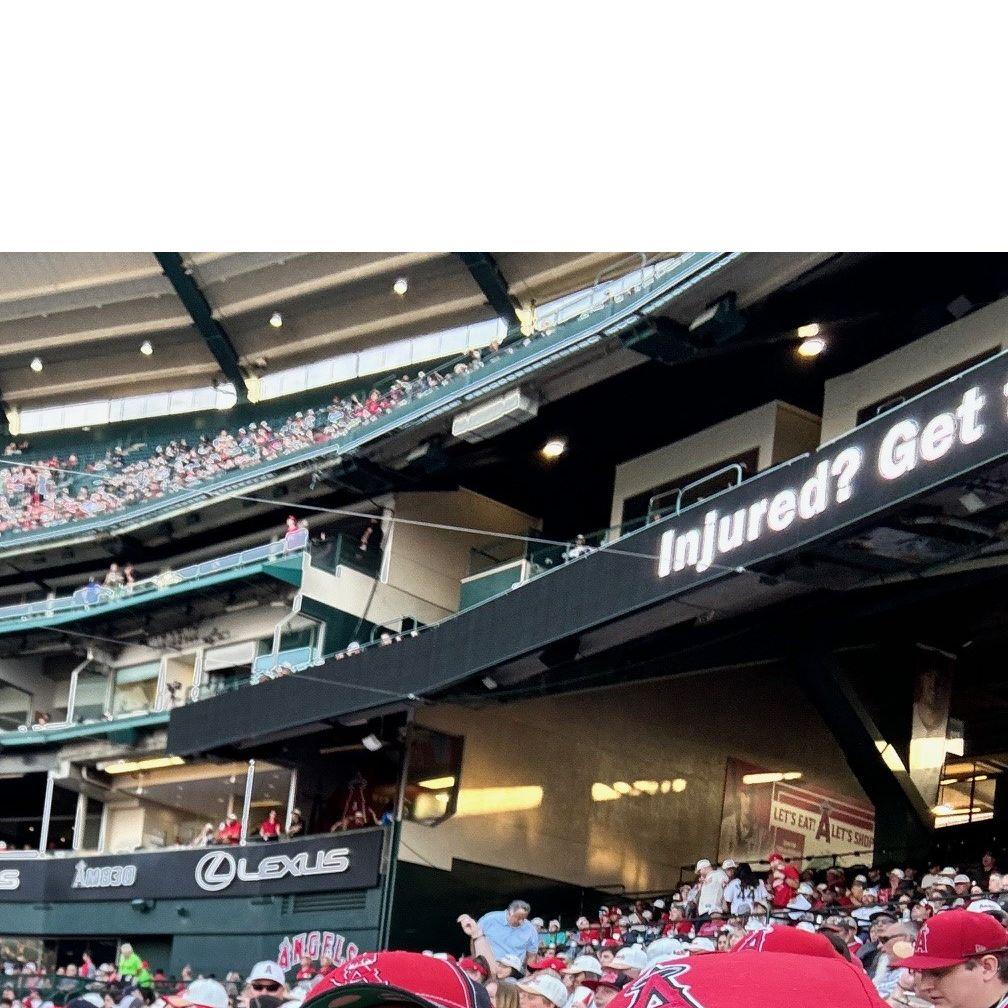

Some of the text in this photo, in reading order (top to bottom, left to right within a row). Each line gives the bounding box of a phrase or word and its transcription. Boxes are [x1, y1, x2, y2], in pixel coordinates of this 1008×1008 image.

[657, 446, 863, 578] Injured?
[877, 386, 987, 480] Get
[72, 859, 137, 888] AM830
[237, 848, 349, 881] LEXUS
